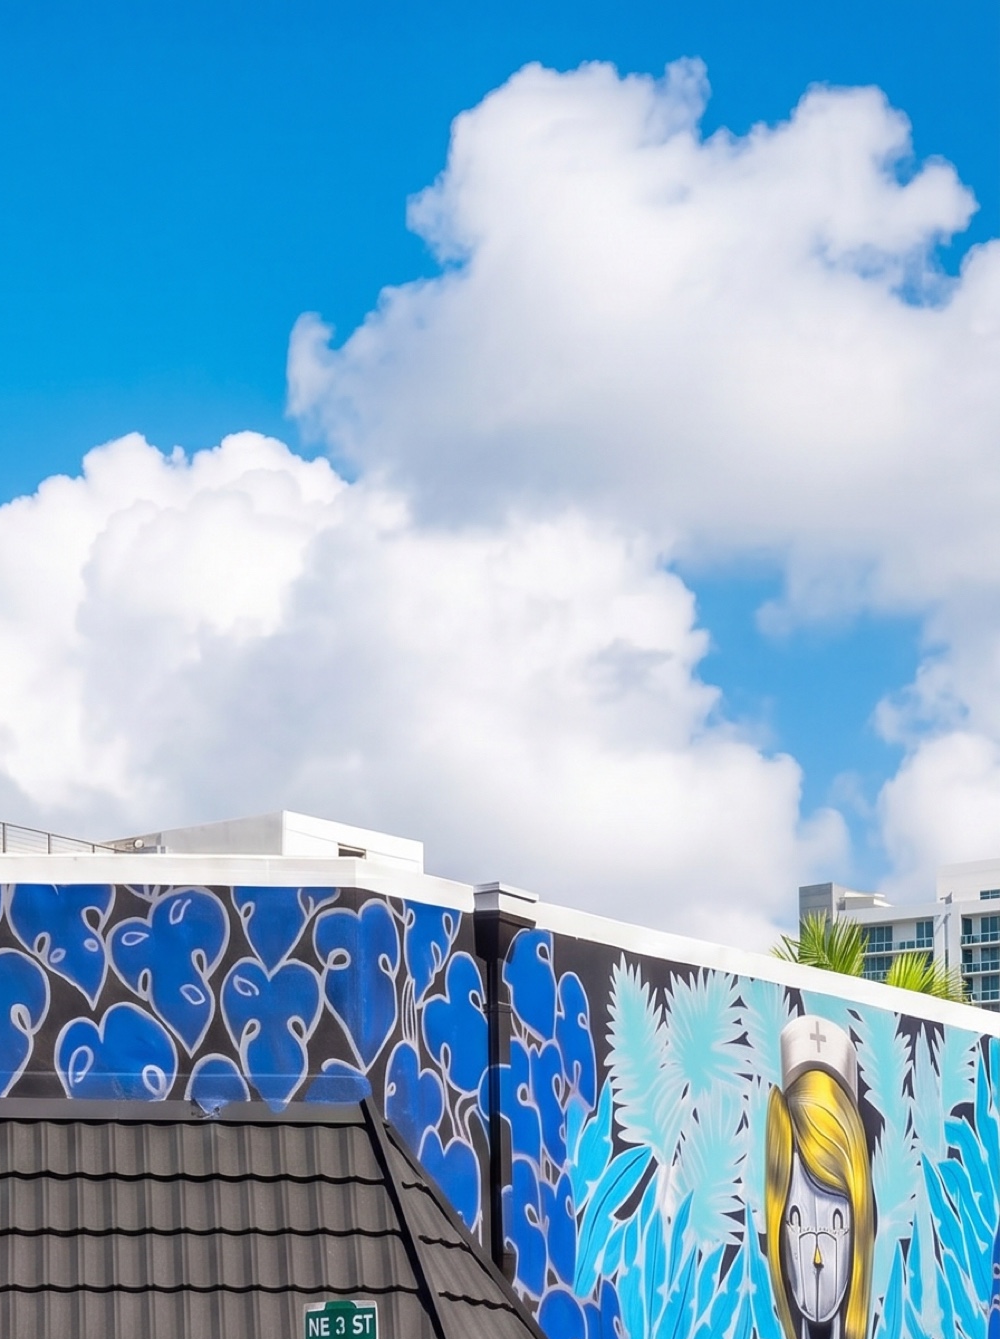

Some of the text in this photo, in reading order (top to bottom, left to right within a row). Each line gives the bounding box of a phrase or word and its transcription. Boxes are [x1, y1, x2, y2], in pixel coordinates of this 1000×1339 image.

[308, 1314, 373, 1337] NE 3 ST
